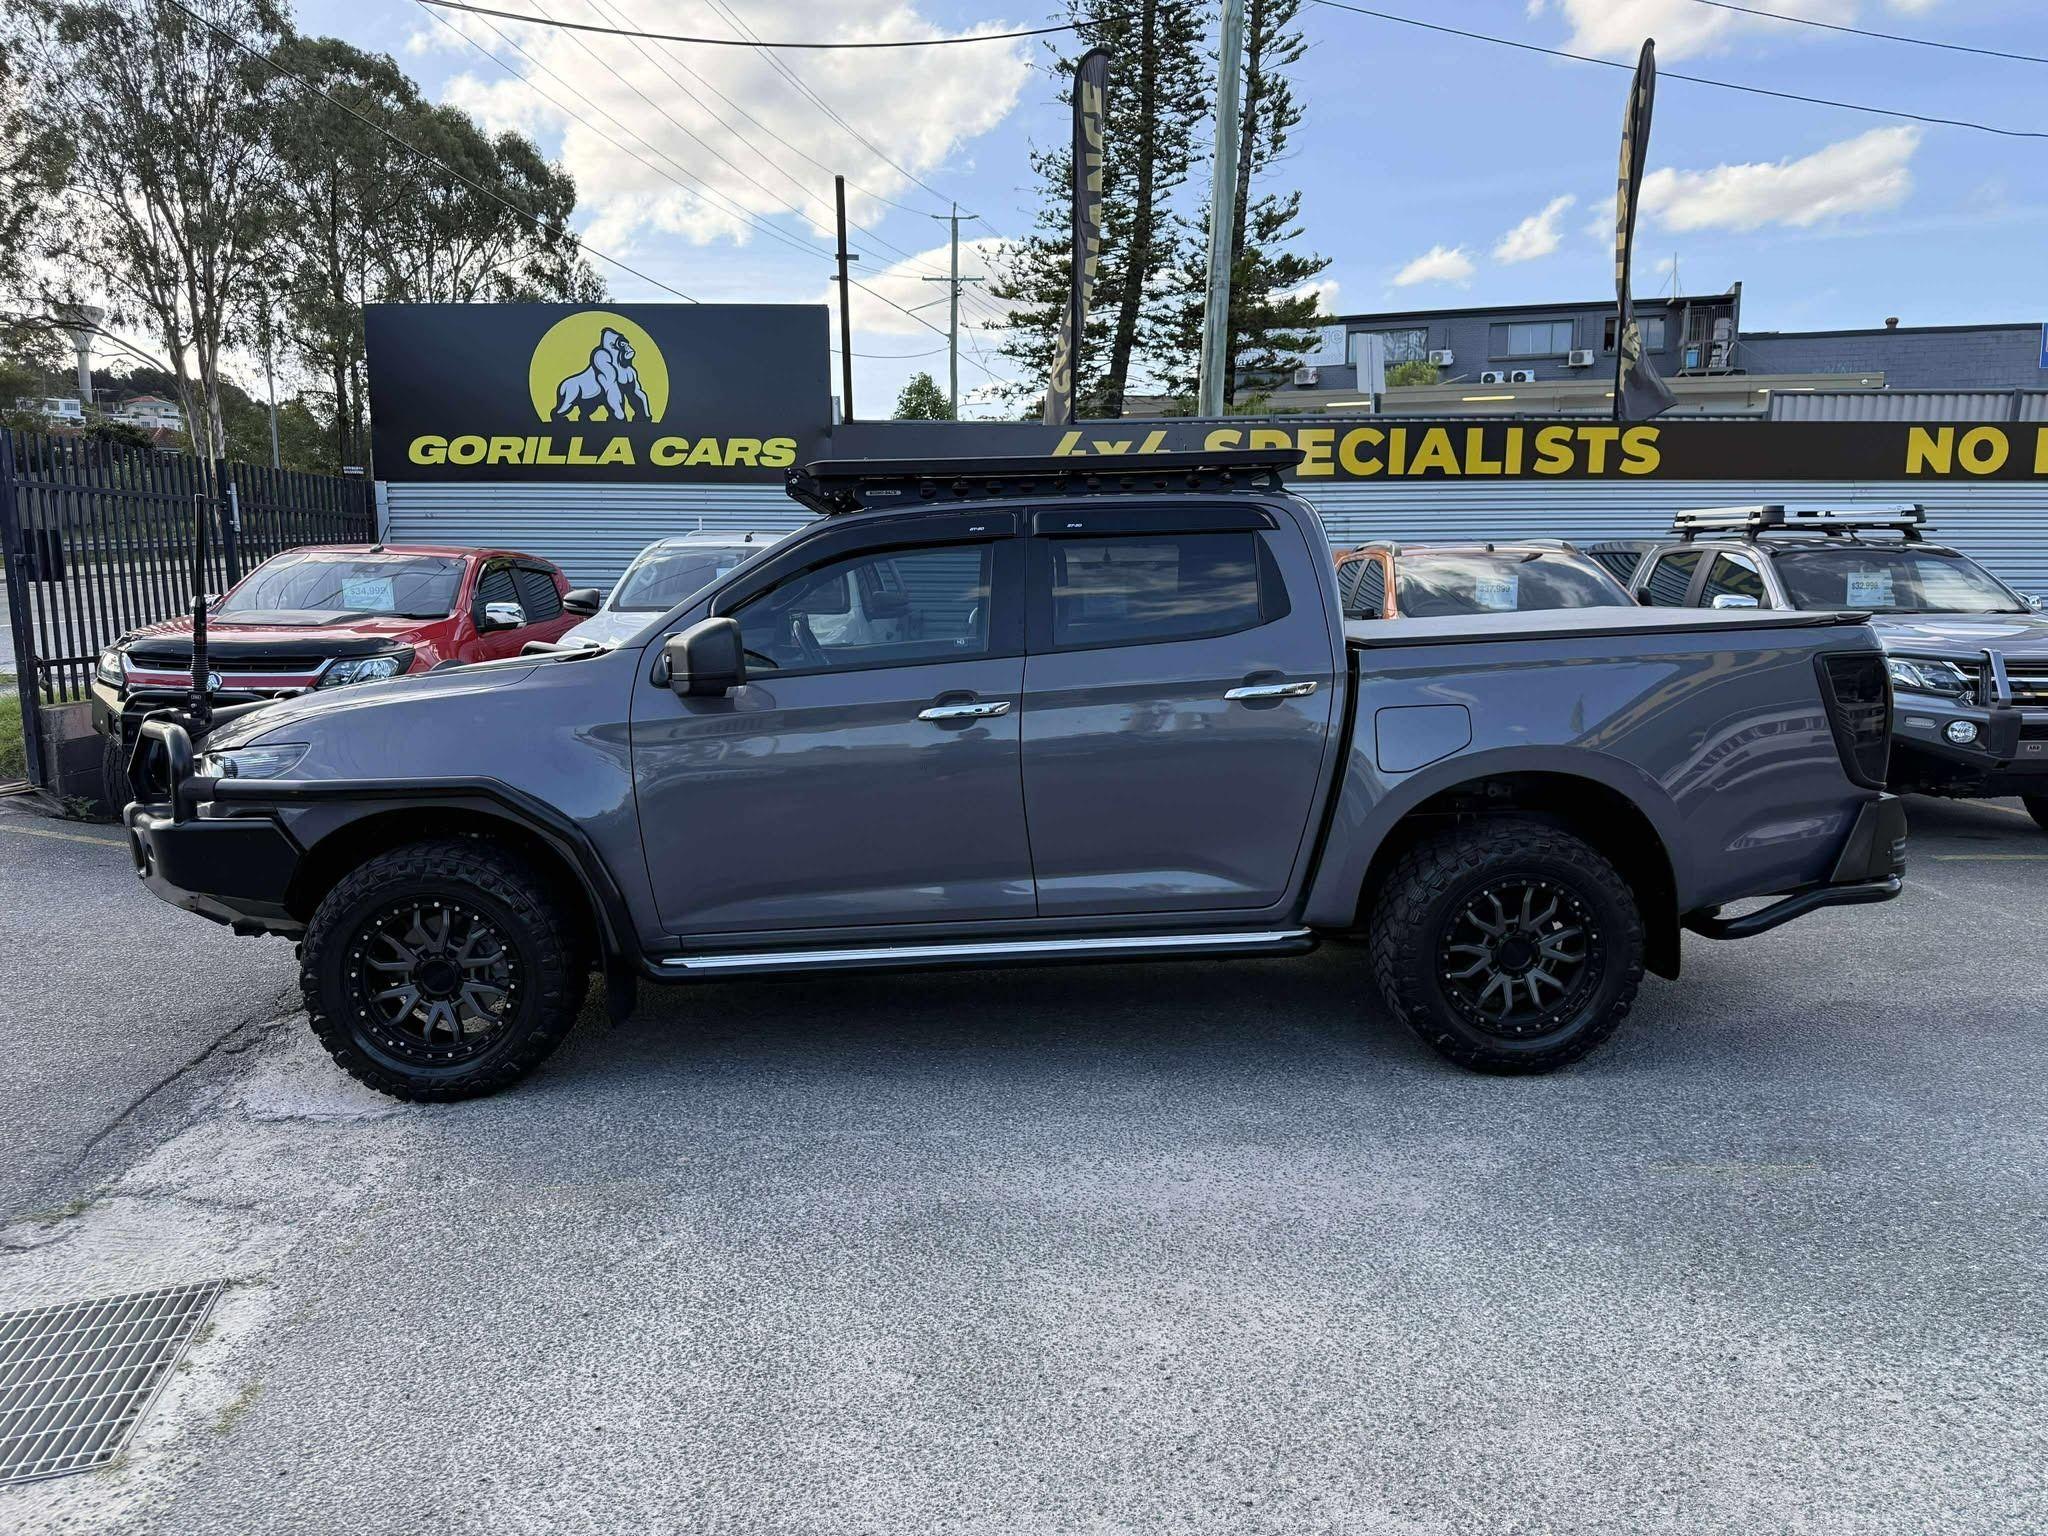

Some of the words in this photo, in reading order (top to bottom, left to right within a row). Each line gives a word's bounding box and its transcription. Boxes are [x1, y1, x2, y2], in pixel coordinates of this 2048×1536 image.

[408, 435, 636, 465] GORILLA
[649, 437, 798, 467] CARS
[1906, 426, 2010, 475] NO
